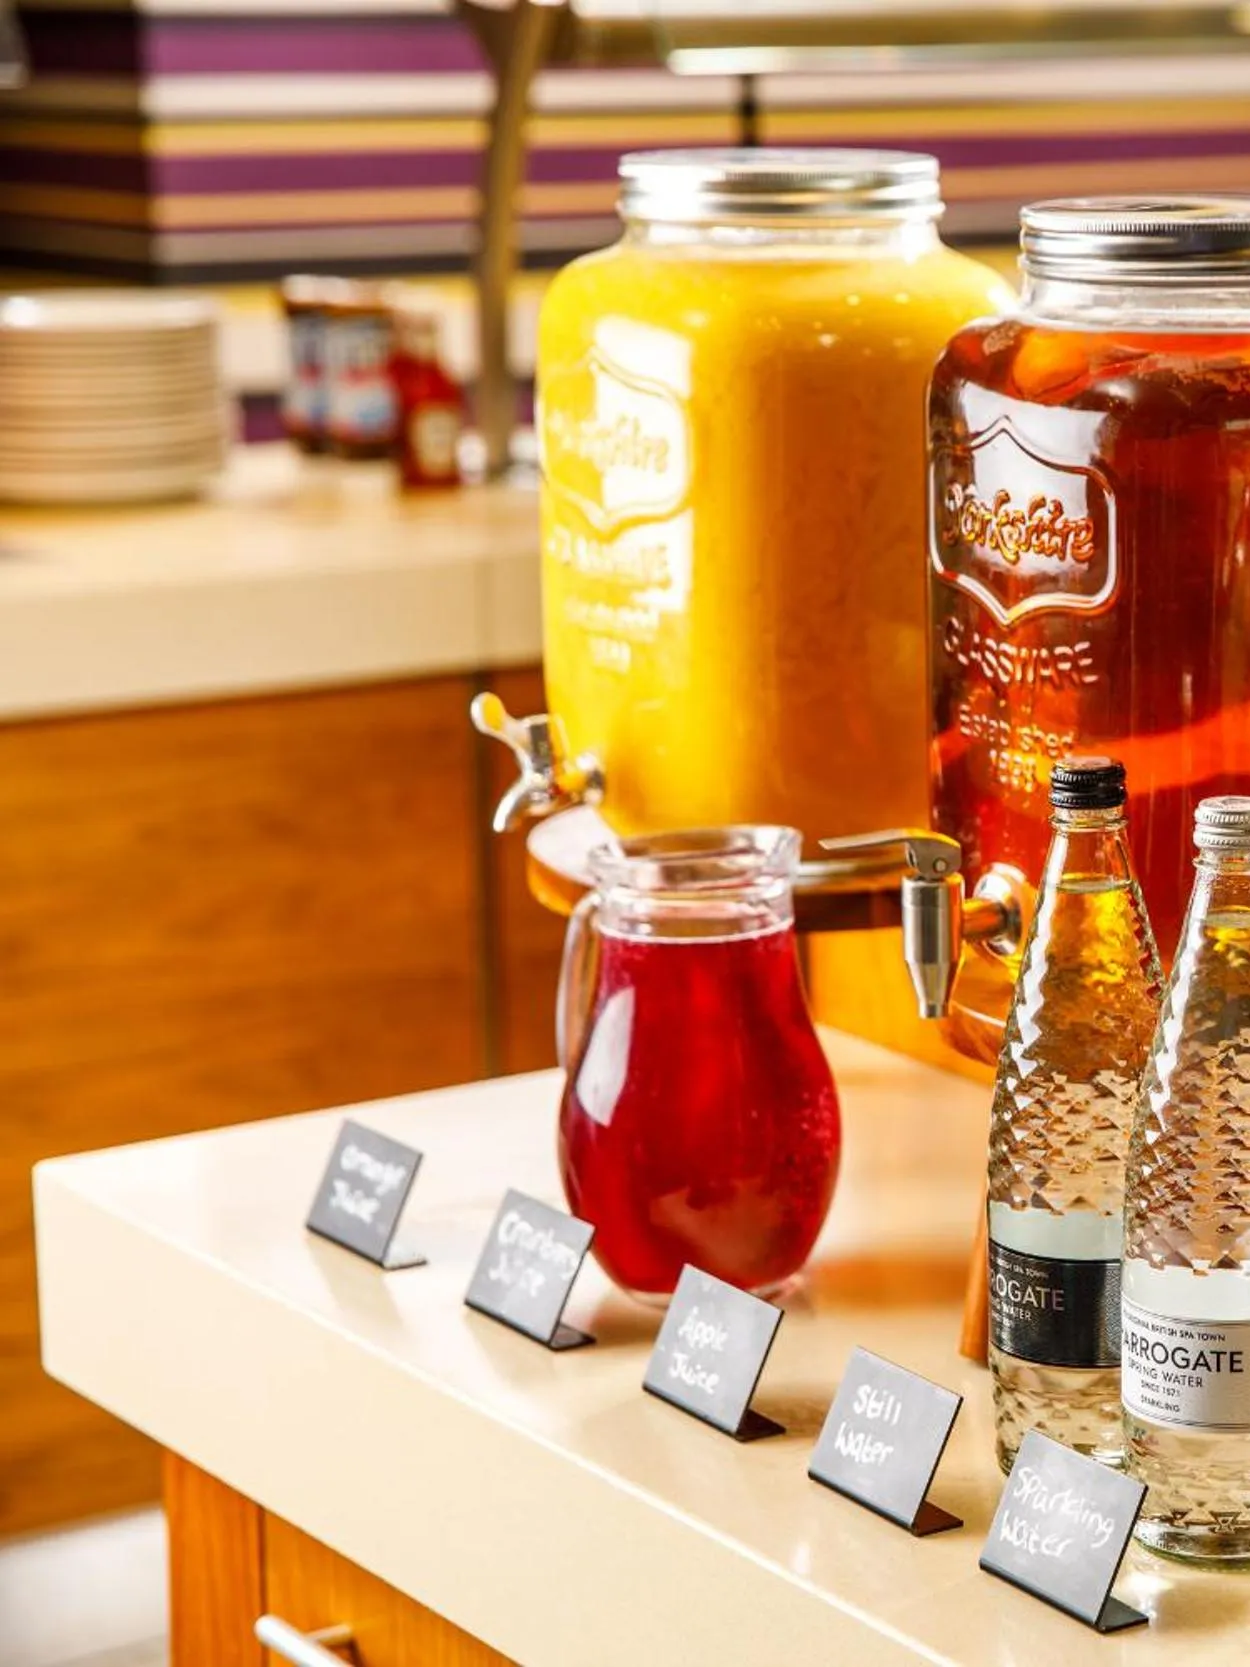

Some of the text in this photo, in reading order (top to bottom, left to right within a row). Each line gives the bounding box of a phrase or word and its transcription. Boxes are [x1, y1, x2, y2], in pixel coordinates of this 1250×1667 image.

[989, 1268, 1065, 1311] ROGATE
[677, 1304, 729, 1353] Apple
[1122, 1327, 1245, 1374] ARROGATE
[1179, 1329, 1196, 1340] SPA
[1197, 1332, 1226, 1343] TOWN
[668, 1351, 721, 1396] Juice
[1161, 1370, 1205, 1388] WATER
[852, 1384, 902, 1428] Still
[834, 1420, 895, 1468] Water
[1013, 1466, 1117, 1549] Sparkling
